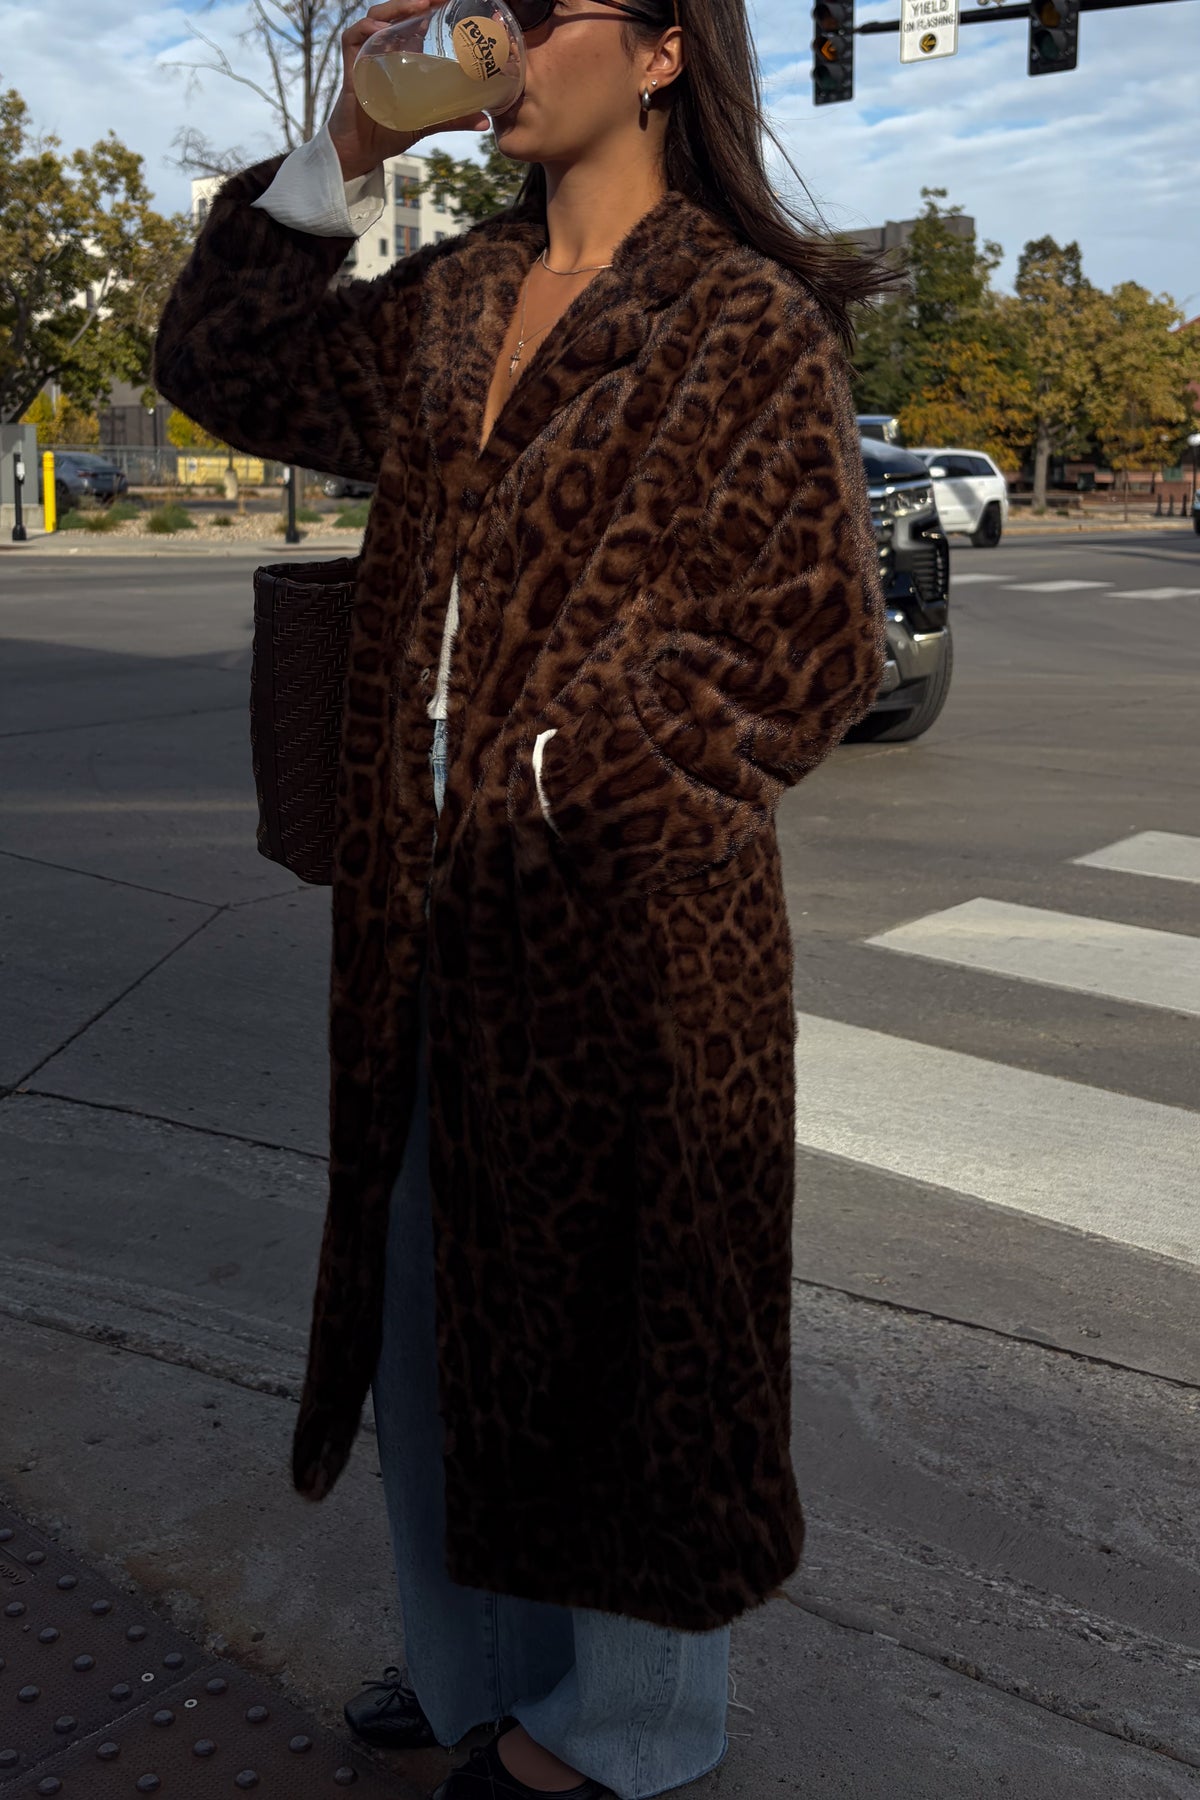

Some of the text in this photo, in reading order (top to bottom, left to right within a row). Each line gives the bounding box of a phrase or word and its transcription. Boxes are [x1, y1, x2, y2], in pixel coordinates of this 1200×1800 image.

[911, 0, 949, 17] YIELD
[904, 14, 954, 33] ON FLASHING
[462, 20, 501, 78] revival
